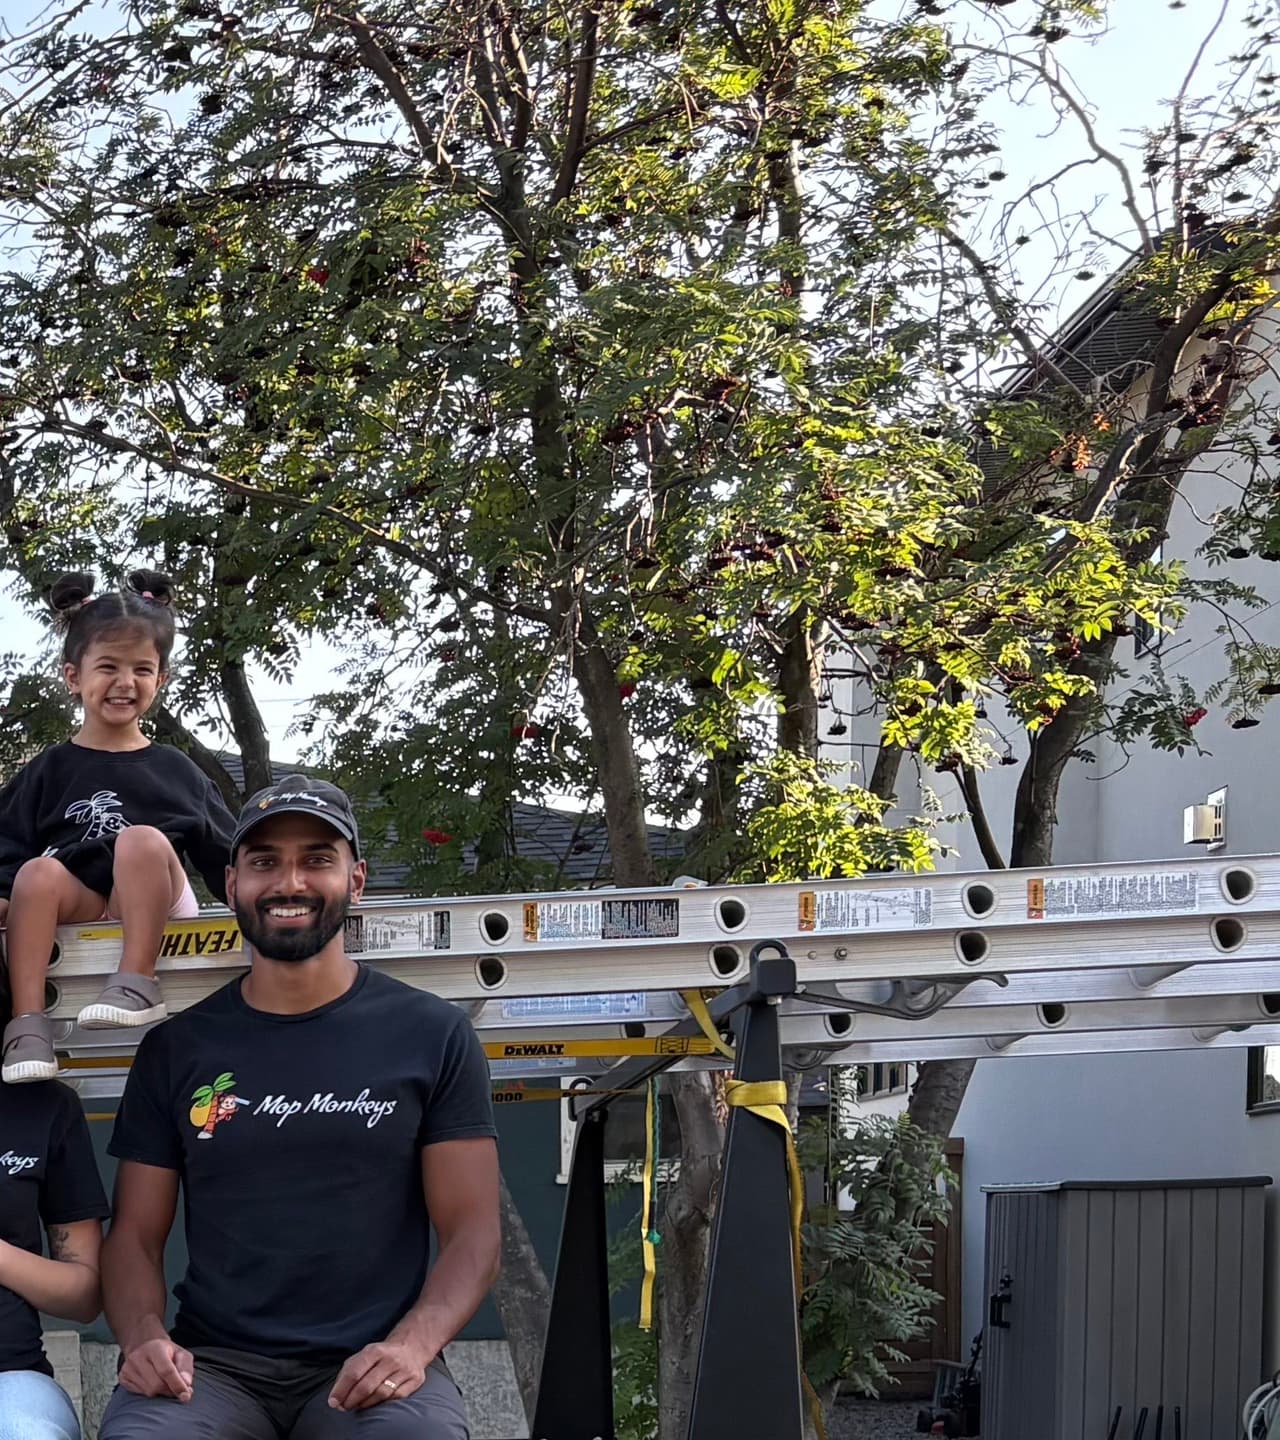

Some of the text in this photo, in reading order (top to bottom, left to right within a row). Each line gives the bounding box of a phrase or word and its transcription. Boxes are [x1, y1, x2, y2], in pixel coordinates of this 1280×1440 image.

[160, 930, 239, 957] FEATH
[253, 1088, 398, 1128] Mop Monkeys
